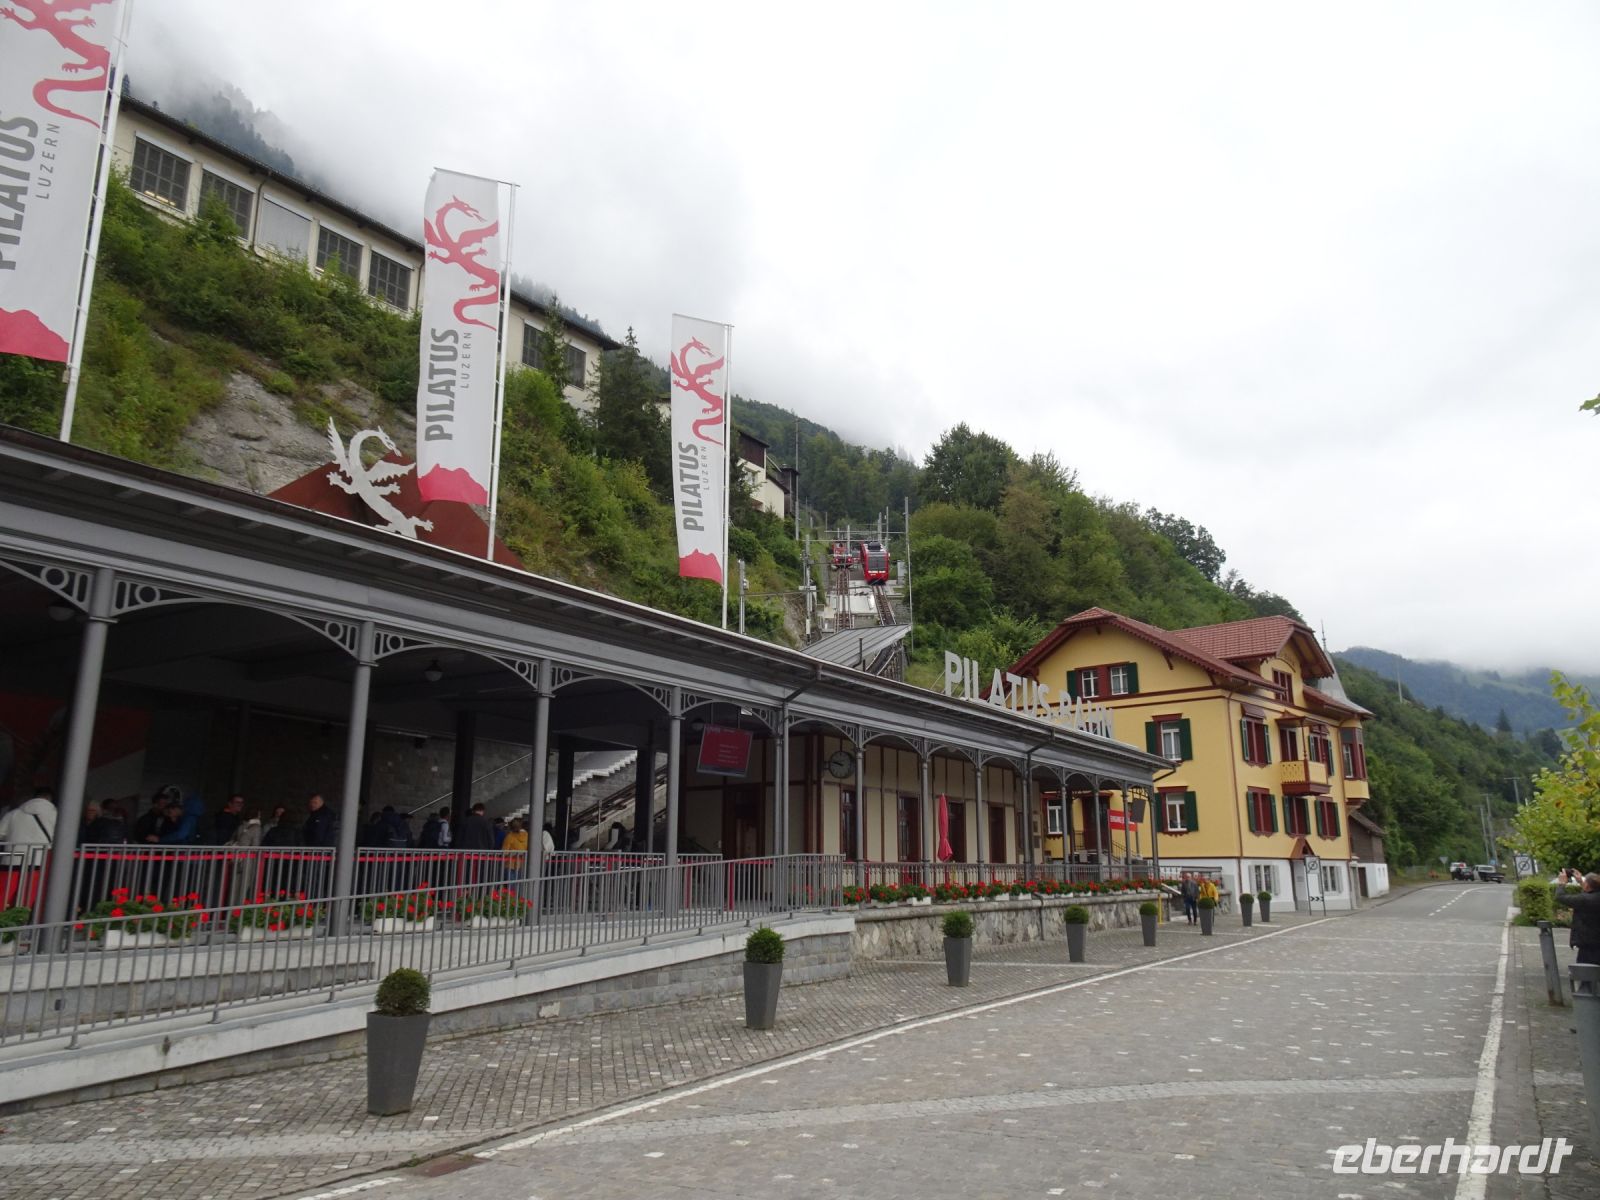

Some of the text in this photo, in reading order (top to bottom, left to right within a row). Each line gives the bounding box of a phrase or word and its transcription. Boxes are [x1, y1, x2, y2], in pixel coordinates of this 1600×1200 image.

[36, 123, 61, 200] LUZERN
[424, 327, 459, 442] PILATUS
[460, 332, 472, 389] LUZERN
[678, 441, 705, 532] PILATUS
[700, 446, 710, 491] LUZERN
